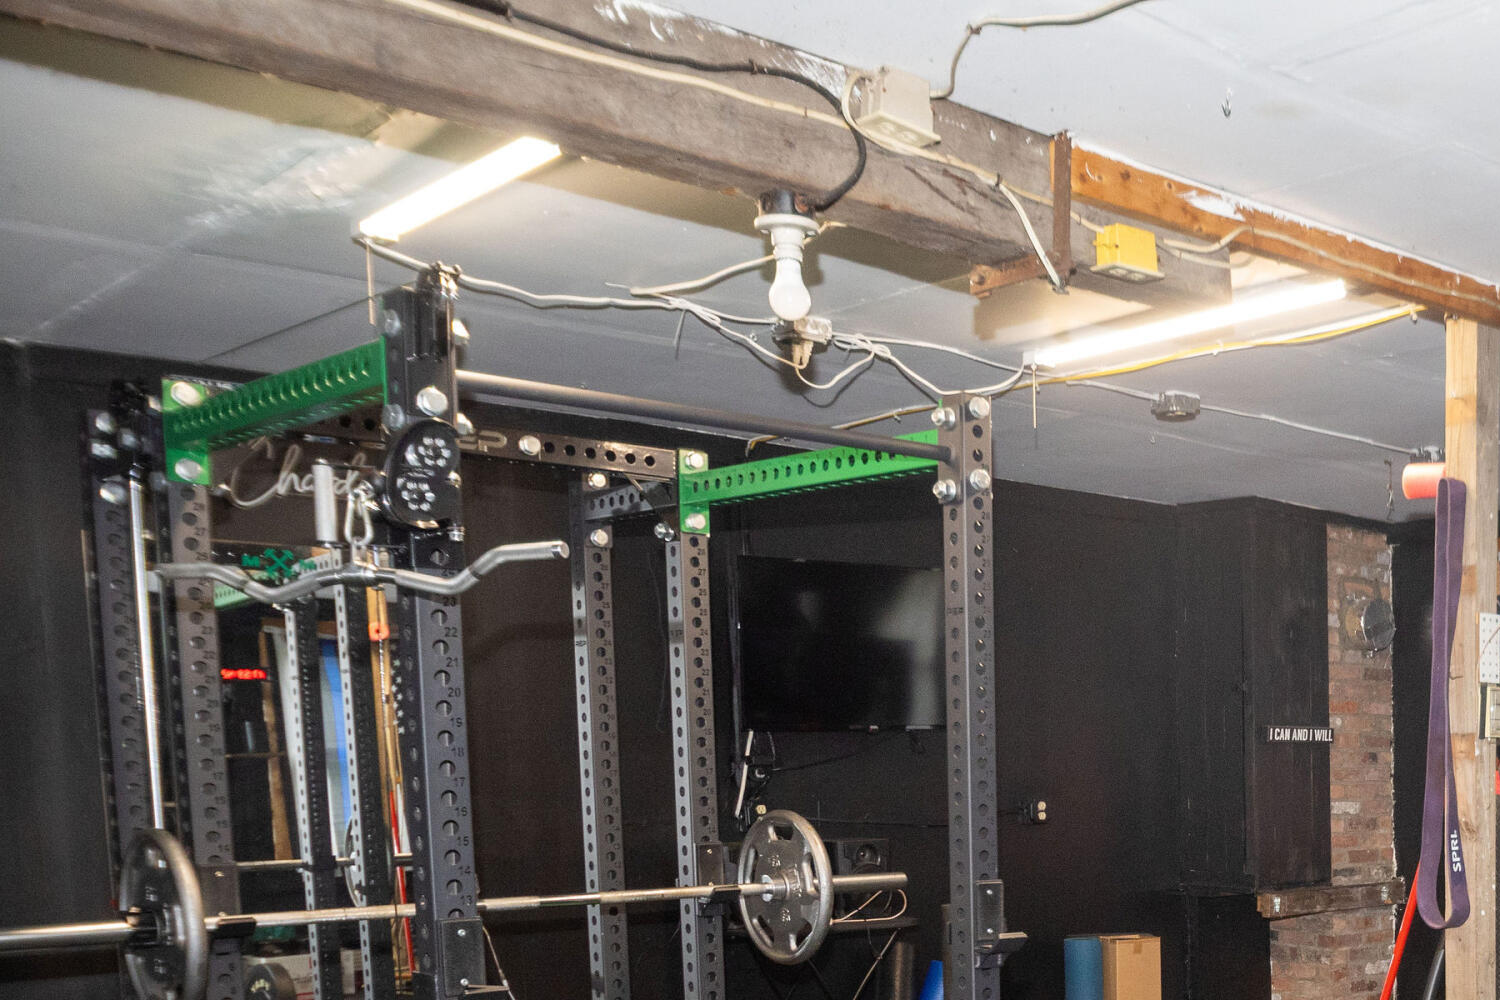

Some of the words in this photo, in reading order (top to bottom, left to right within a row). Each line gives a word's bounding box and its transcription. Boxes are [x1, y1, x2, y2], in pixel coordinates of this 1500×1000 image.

[444, 627, 458, 637] 22
[446, 657, 459, 667] 21
[447, 688, 461, 698] 20
[450, 718, 463, 728] 19
[1274, 728, 1290, 741] CAN
[1292, 728, 1308, 741] AND
[1314, 729, 1333, 742] WILL
[455, 807, 468, 817] 16
[457, 837, 470, 847] 15
[459, 866, 471, 876] 14
